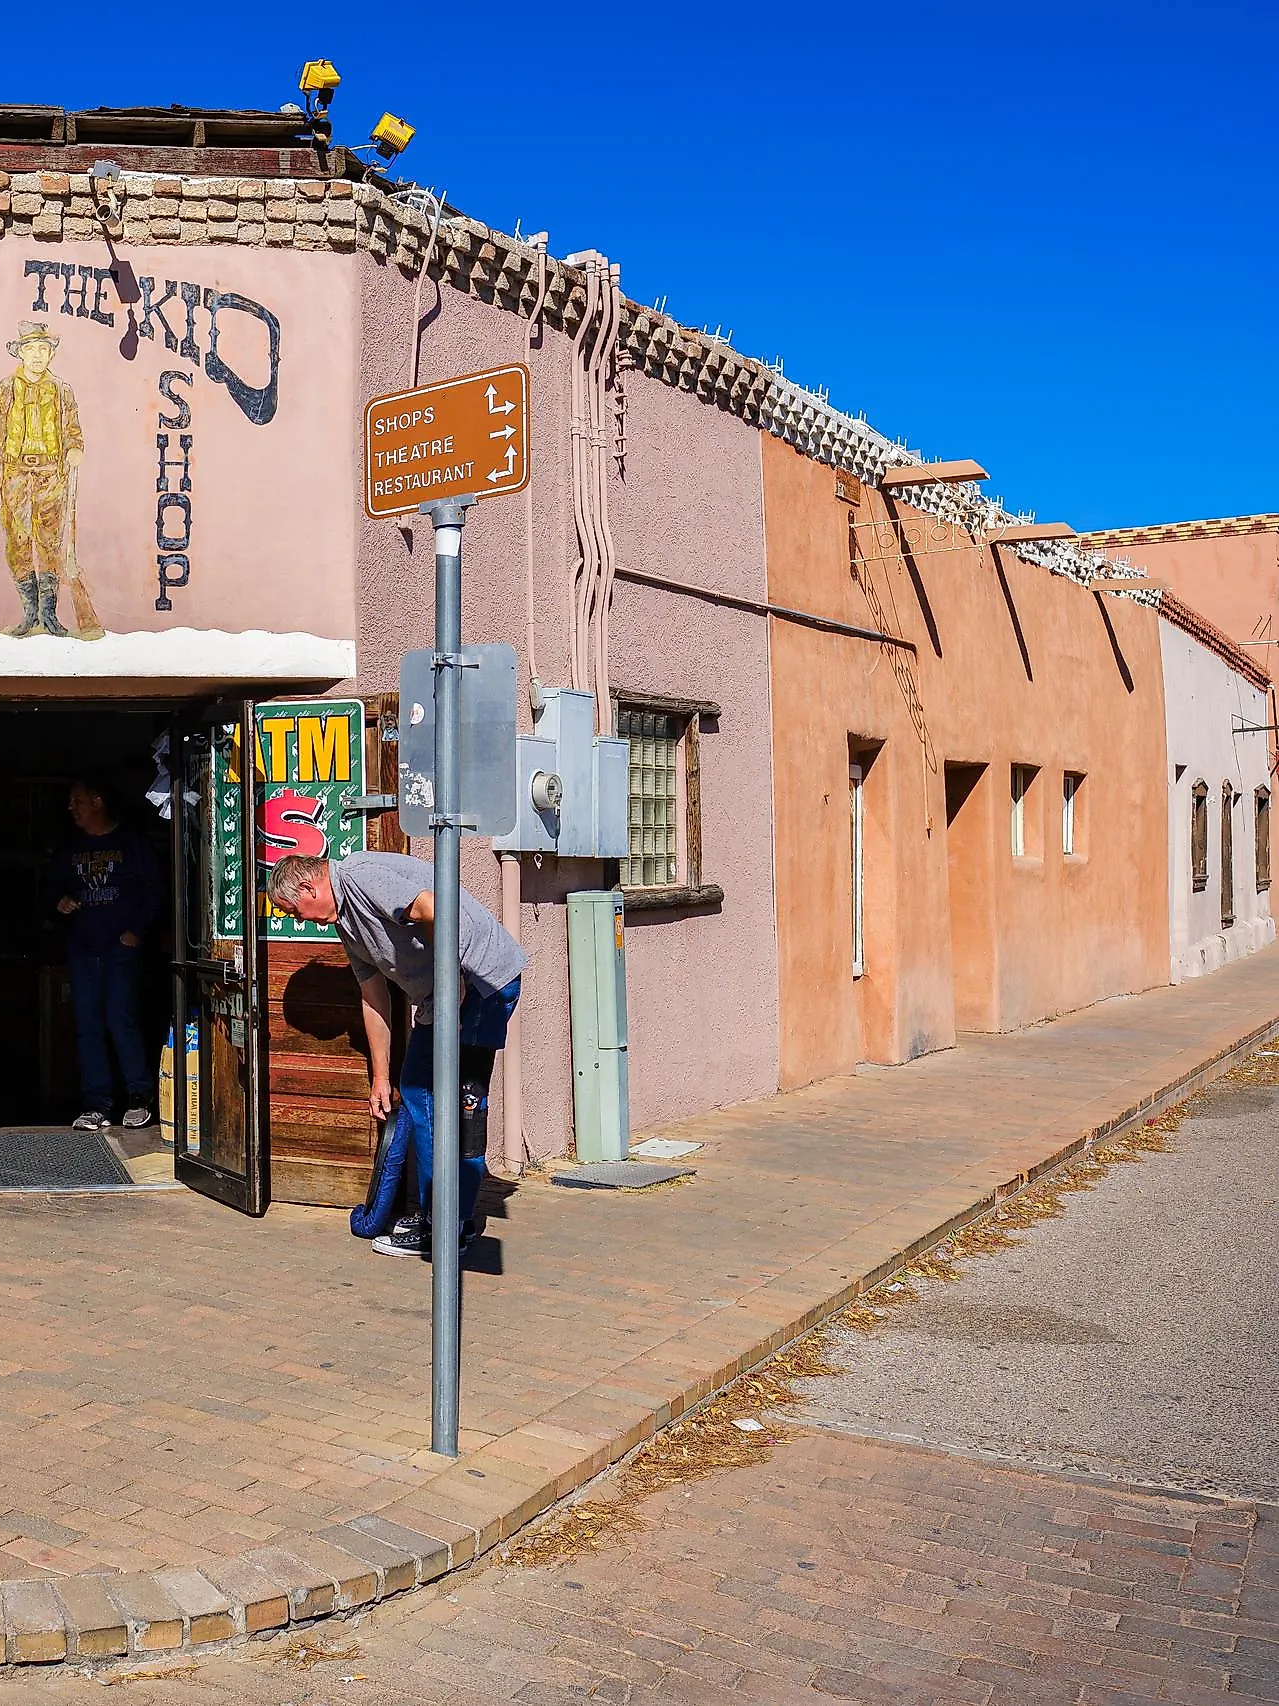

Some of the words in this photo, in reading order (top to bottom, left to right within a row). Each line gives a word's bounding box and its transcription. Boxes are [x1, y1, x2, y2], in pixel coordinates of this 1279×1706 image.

[23, 260, 116, 327] THE
[138, 275, 281, 426] KID
[374, 406, 435, 436] SHOPS
[374, 435, 454, 468] THEATRE
[154, 370, 194, 612] SHOP
[374, 461, 475, 497] RESTAURANT
[224, 715, 352, 783] ATM
